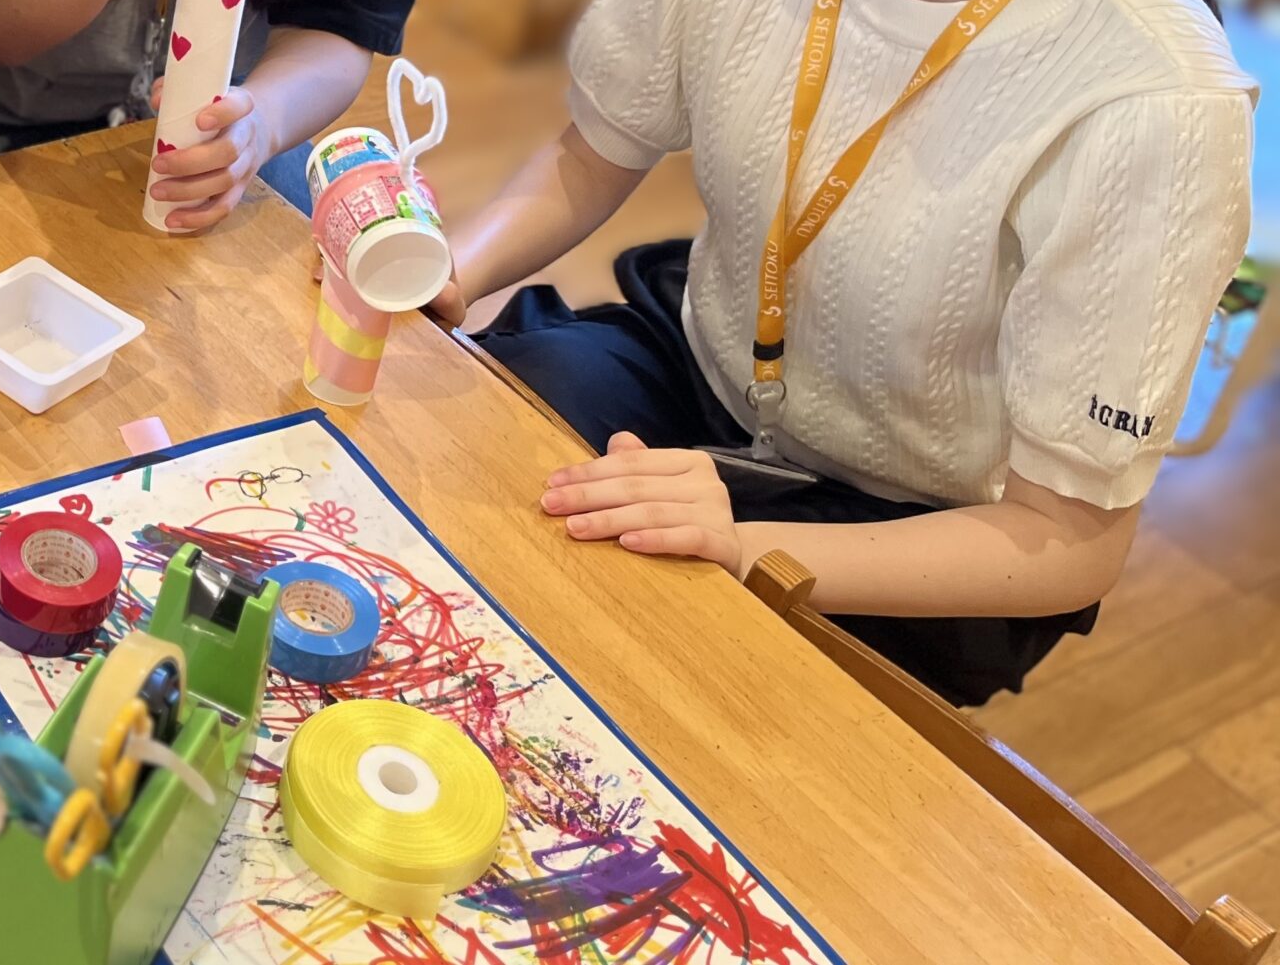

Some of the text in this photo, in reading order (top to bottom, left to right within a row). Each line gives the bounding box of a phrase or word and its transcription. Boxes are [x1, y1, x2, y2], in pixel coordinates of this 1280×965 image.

[803, 16, 830, 87] SEITOKU
[796, 189, 837, 239] SEITOKU
[763, 240, 779, 301] SEITOKU
